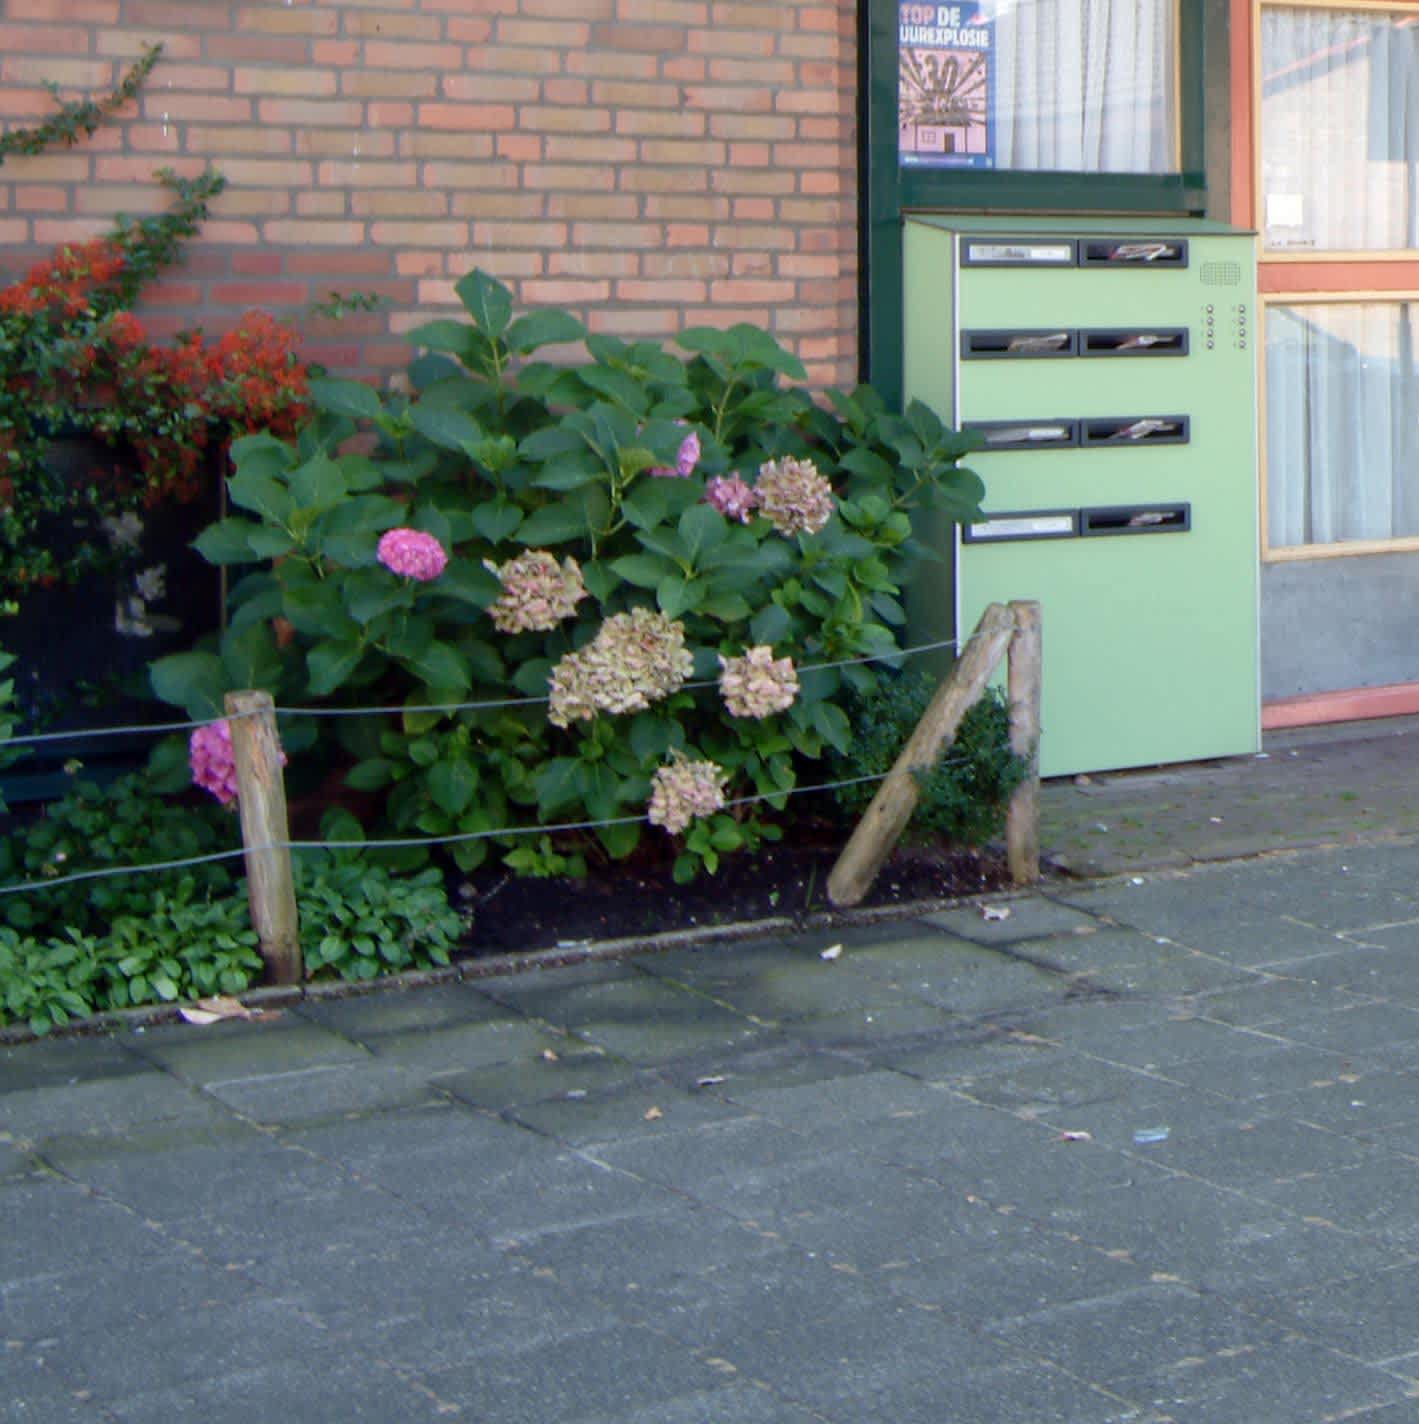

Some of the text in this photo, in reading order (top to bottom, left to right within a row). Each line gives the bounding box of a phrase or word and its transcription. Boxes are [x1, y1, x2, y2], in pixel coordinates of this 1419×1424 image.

[899, 3, 961, 28] TOP DE
[899, 24, 990, 48] UUREXPLOSIE
